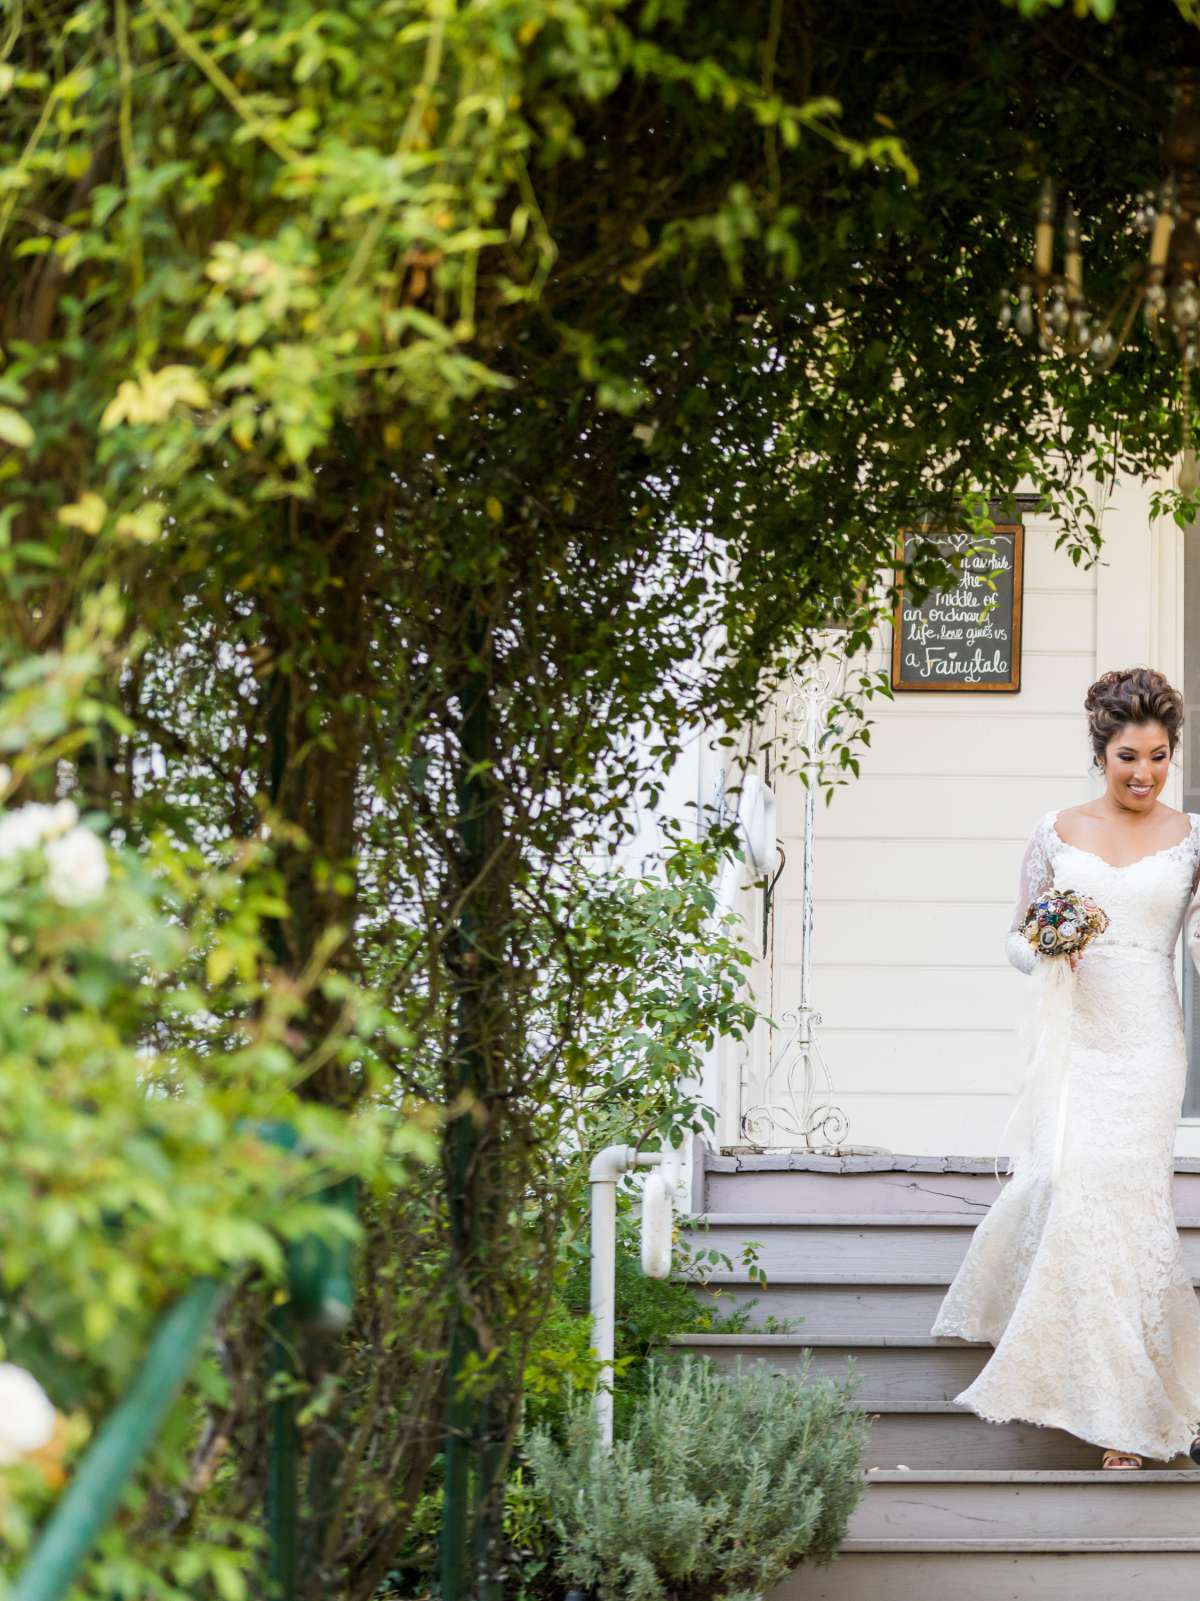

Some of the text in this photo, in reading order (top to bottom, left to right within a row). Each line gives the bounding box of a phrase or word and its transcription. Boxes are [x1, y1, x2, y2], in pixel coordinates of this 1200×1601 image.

[959, 570, 983, 589] the
[935, 589, 998, 611] middle of
[903, 607, 991, 627] an ordinary
[907, 623, 1008, 647] life, love gives us
[905, 647, 1009, 682] a Fairytale
